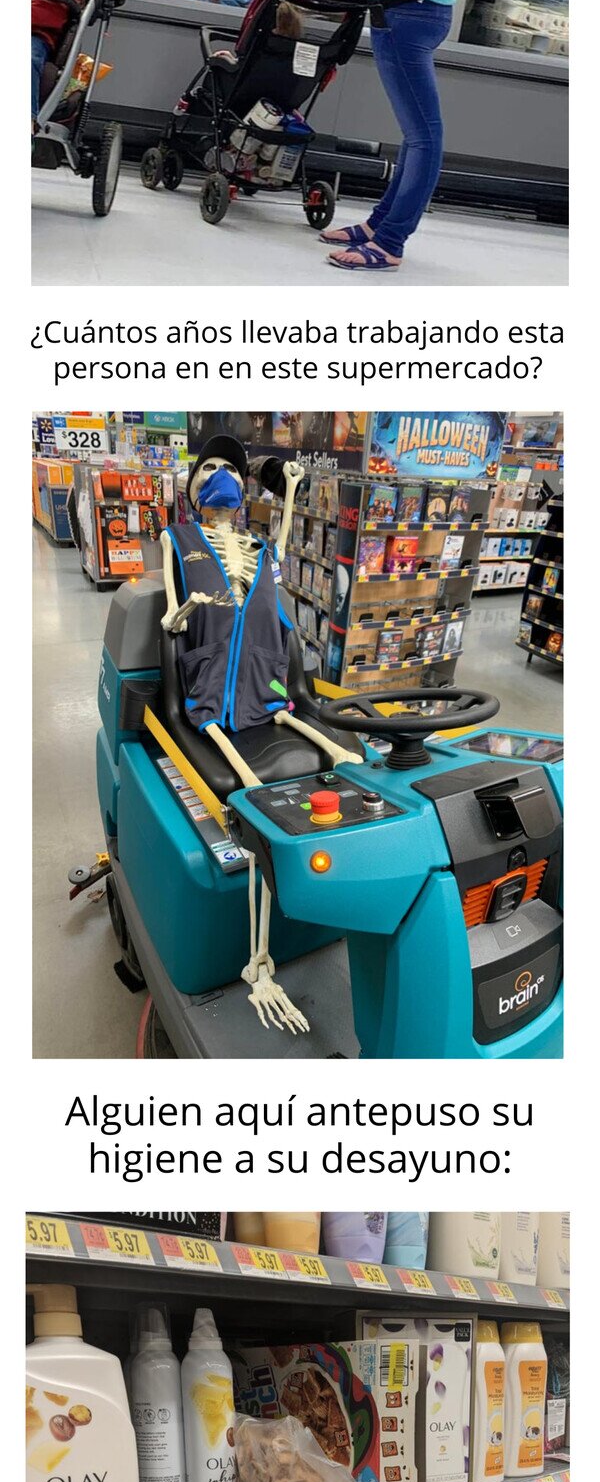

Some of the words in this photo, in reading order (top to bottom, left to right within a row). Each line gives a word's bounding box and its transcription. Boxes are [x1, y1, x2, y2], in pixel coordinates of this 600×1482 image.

[62, 431, 101, 448] $328
[395, 416, 490, 463] HALLOWEEN
[296, 450, 312, 466] Best
[312, 451, 339, 469] Sellers
[416, 448, 470, 467] MUST-HAVES
[499, 981, 539, 1015] brain
[429, 1421, 457, 1433] OLAY
